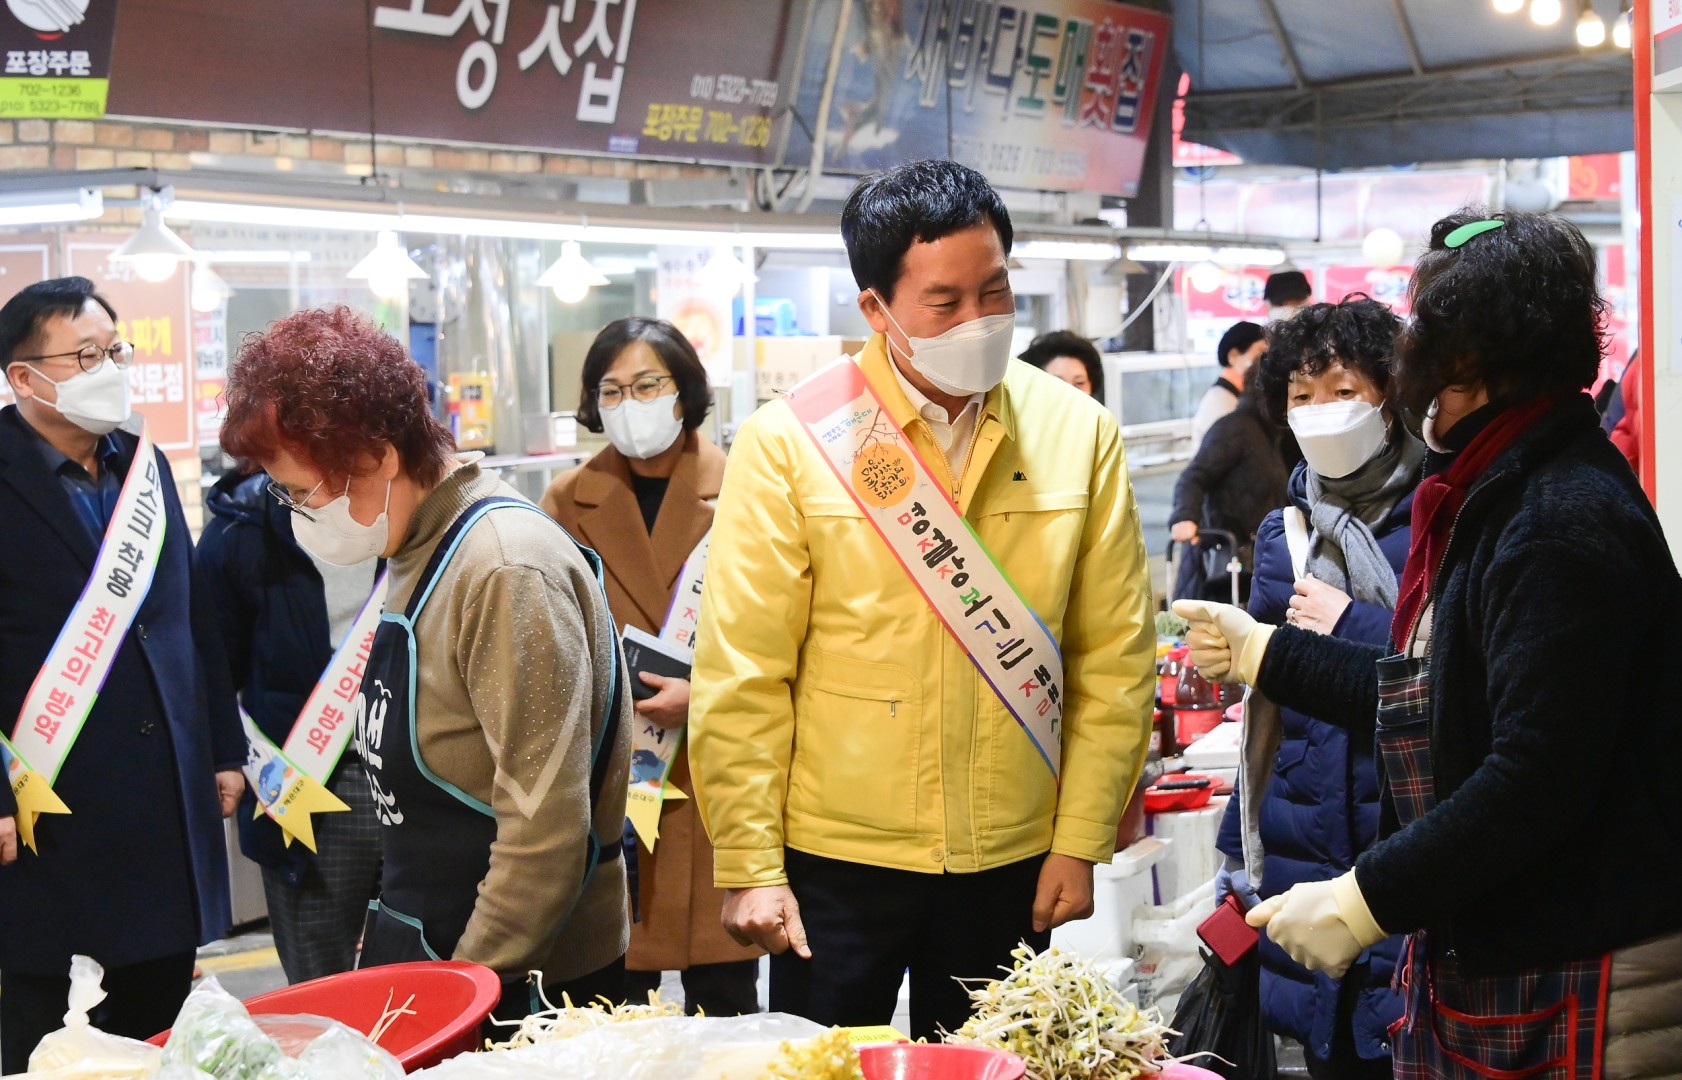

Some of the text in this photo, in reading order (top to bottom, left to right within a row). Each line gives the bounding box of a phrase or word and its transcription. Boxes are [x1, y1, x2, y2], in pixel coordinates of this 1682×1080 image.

[5, 49, 92, 76] 포장주문
[19, 83, 81, 96] 702-1236
[642, 103, 703, 143] 포장주문
[106, 540, 145, 598] 착용
[60, 605, 117, 687] 최고의
[33, 687, 75, 745] 방역
[306, 703, 346, 756] 방역
[283, 779, 305, 807] 해운대구
